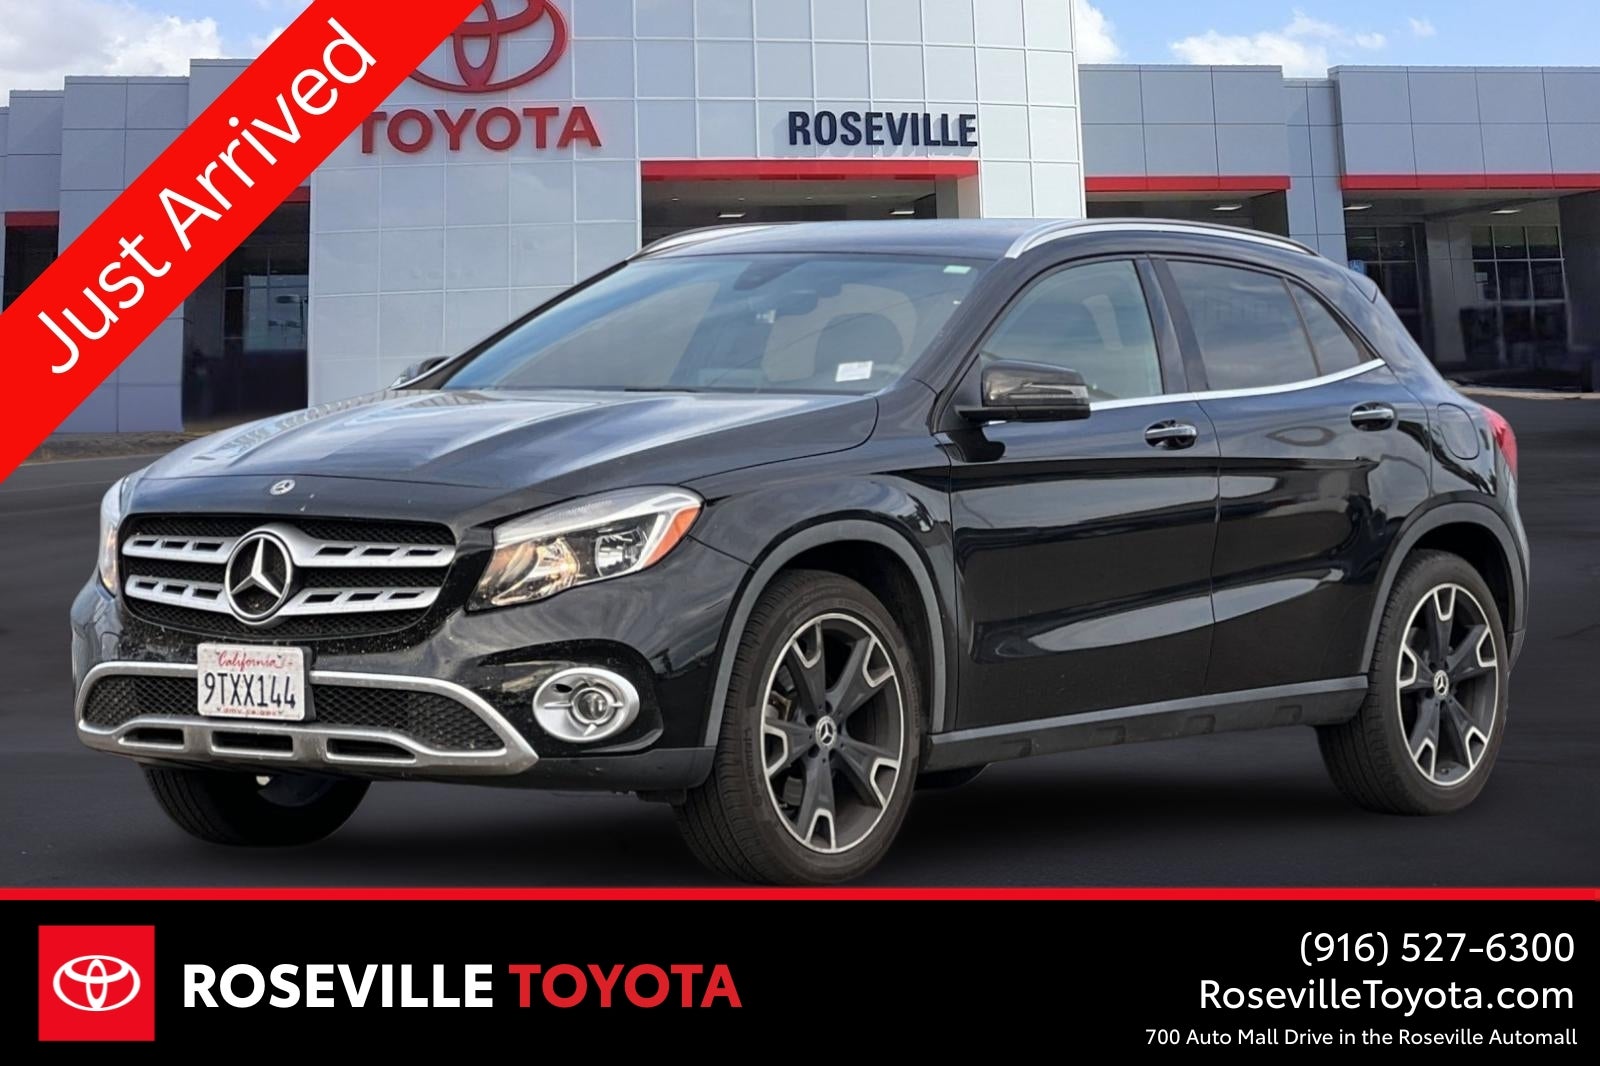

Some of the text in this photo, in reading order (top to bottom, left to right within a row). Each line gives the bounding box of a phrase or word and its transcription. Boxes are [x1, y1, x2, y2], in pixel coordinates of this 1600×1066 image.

[361, 106, 602, 154] TOYOTA
[788, 110, 978, 147] ROSEVILLE
[216, 650, 284, 671] California
[204, 672, 296, 708] 9TXX144
